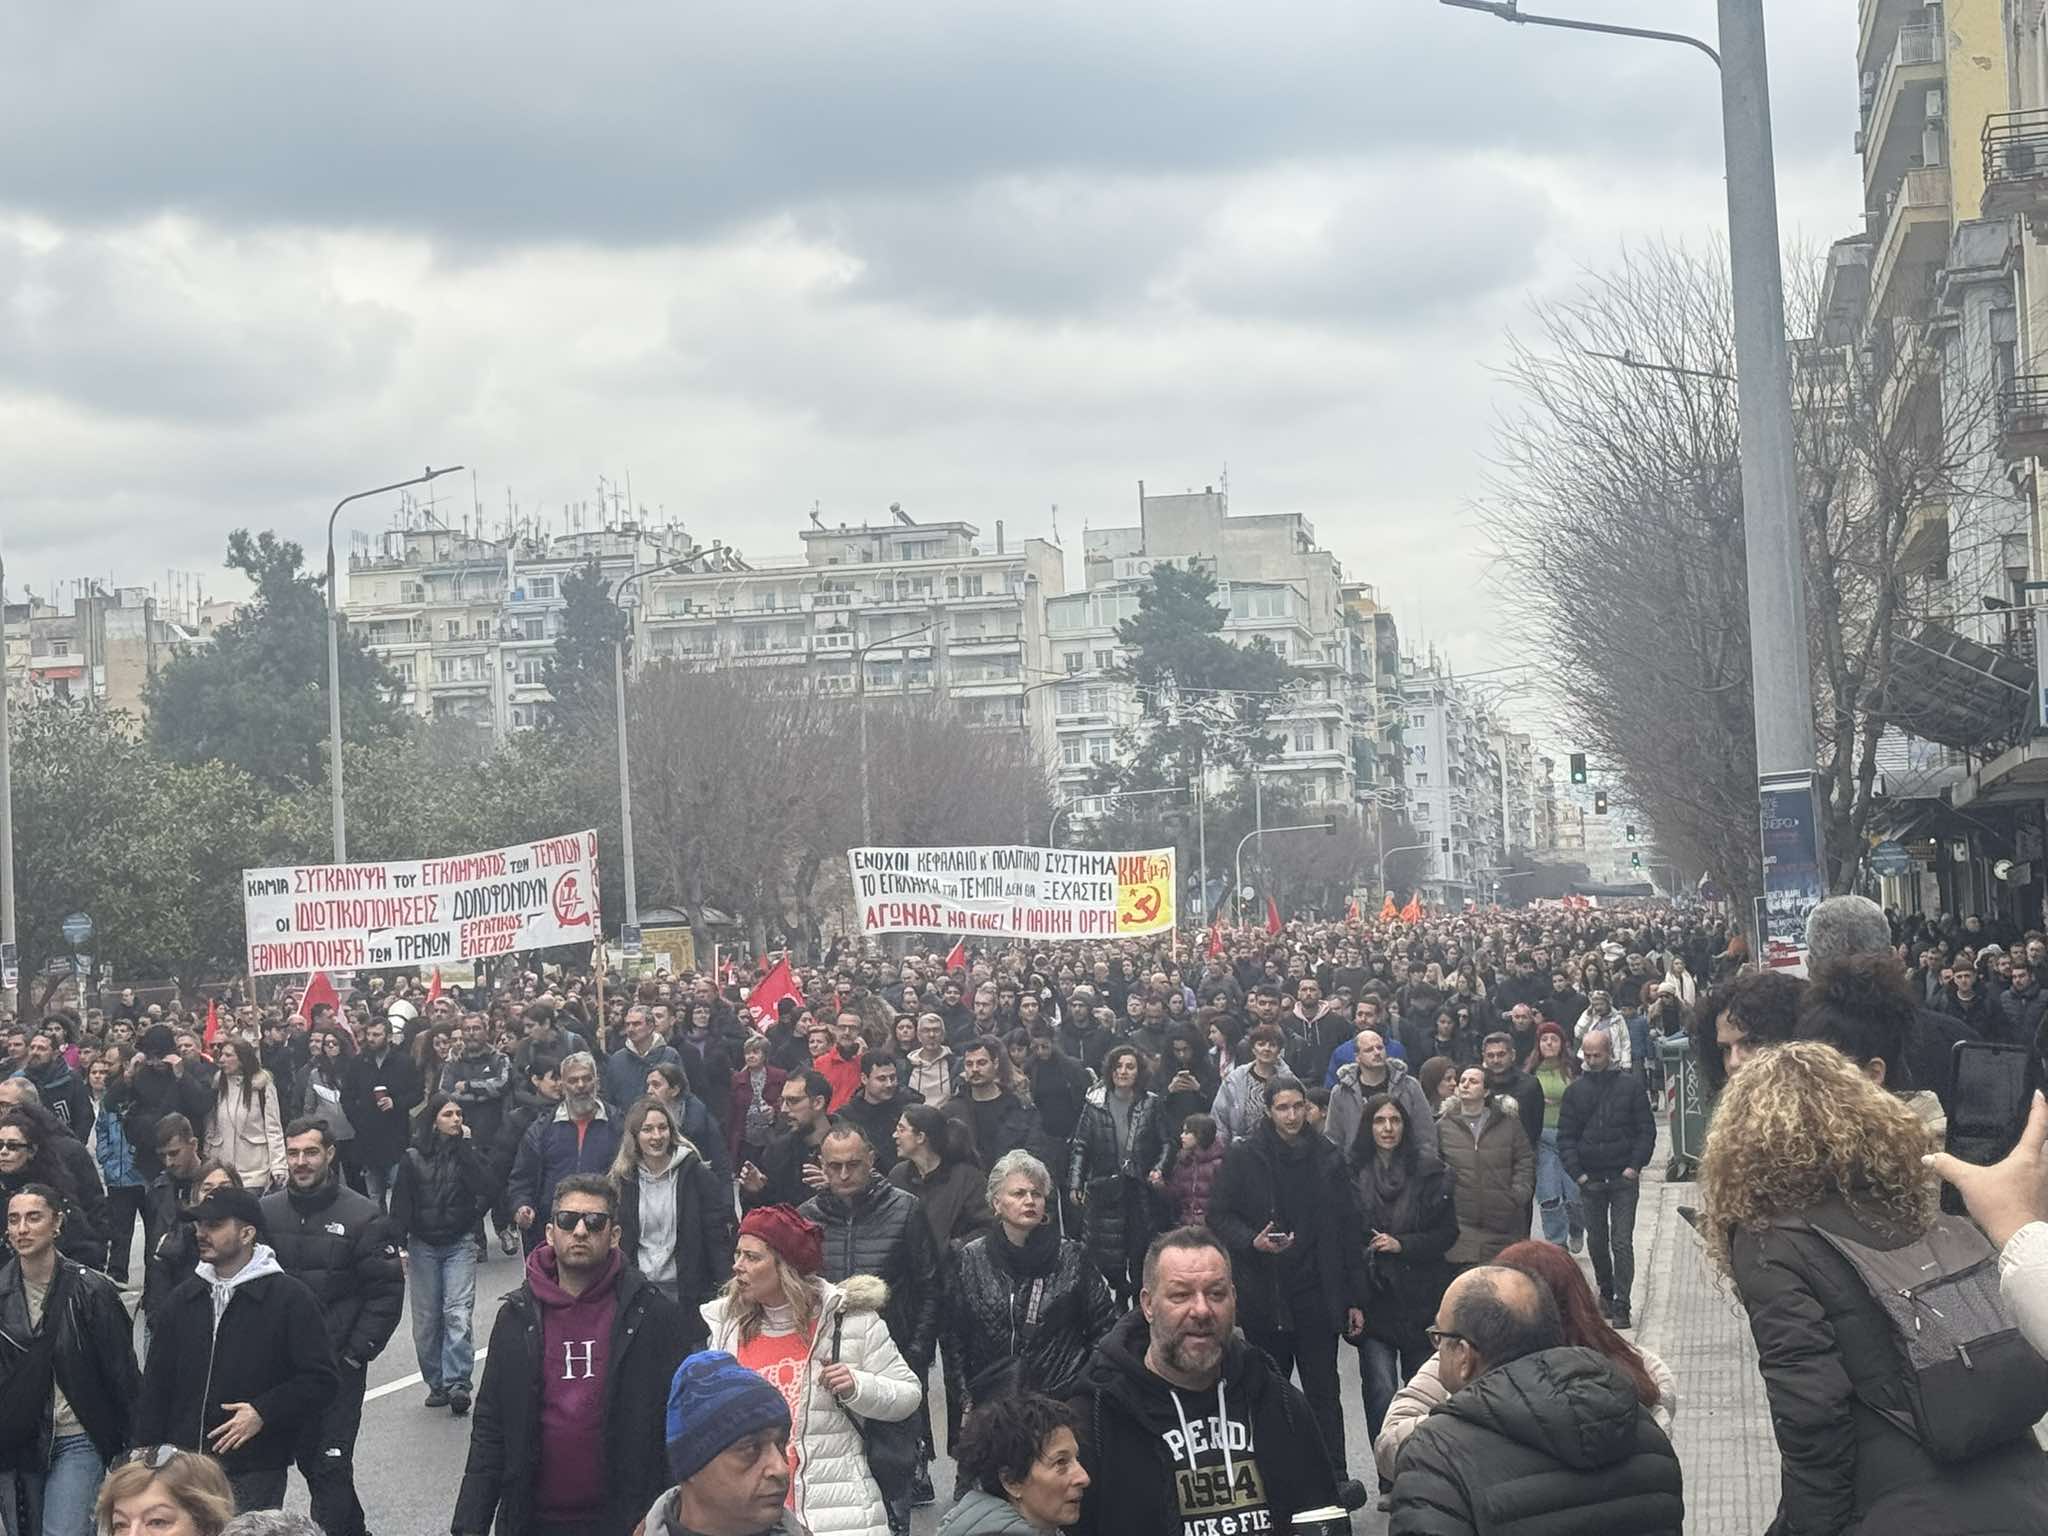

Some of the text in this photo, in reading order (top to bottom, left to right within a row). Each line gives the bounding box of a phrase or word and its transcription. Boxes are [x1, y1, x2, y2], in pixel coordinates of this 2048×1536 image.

[247, 837, 581, 897] ΚΑΜΙΑ ΣΥΓΚΑΛΥΨΗ ΤΟΥ ΕΓΚΛΗΜΑΤΟΣ ΤΩΝ ΤΕΜΠΩΝ
[854, 851, 909, 871] ΕΝΟΧΟΙ
[917, 850, 977, 872] ΚΕΦΑΛΑΙΟ
[993, 849, 1040, 872] ΠΟΛΙΤΙΚΟ
[1044, 852, 1118, 876] ΣΥΣΤΗΜΑ
[859, 875, 876, 896] ΤΟ
[880, 873, 942, 895] ΕΓΚΛΗΜΑ
[960, 876, 1002, 899] ΤΕΜΠΗ
[1005, 883, 1023, 896] ΔΕΝ
[1024, 884, 1036, 898] ΘΑ
[1043, 880, 1112, 901] ΞΕΧΑΣΤΕΙ
[276, 877, 548, 932] ΟΙ ΙΔΙΩΤΙΚΟΠΟΙΗΣΕΙΣ ΔΟΛΟΦΟΝΟΥΝ
[866, 903, 942, 930] ΑΓΩΝΑΣ
[947, 910, 967, 929] ΝΑ
[970, 913, 1004, 930] ΓΙΝΕΙ
[1012, 907, 1022, 931] Η
[1079, 910, 1117, 933] ΟΡΓΗ
[460, 914, 524, 939] ΕΡΓΑΤΙΚΟΣ
[251, 931, 451, 973] ΕΘΝΙΚΟΠΟΙΗΣΗ ΤΩΝ ΤΡΕΝΩΝ
[460, 933, 516, 958] ΕΛΕΓΧΟΣ
[561, 1340, 596, 1379] H
[1180, 1465, 1258, 1509] 1994
[1238, 1510, 1272, 1533] FIE
